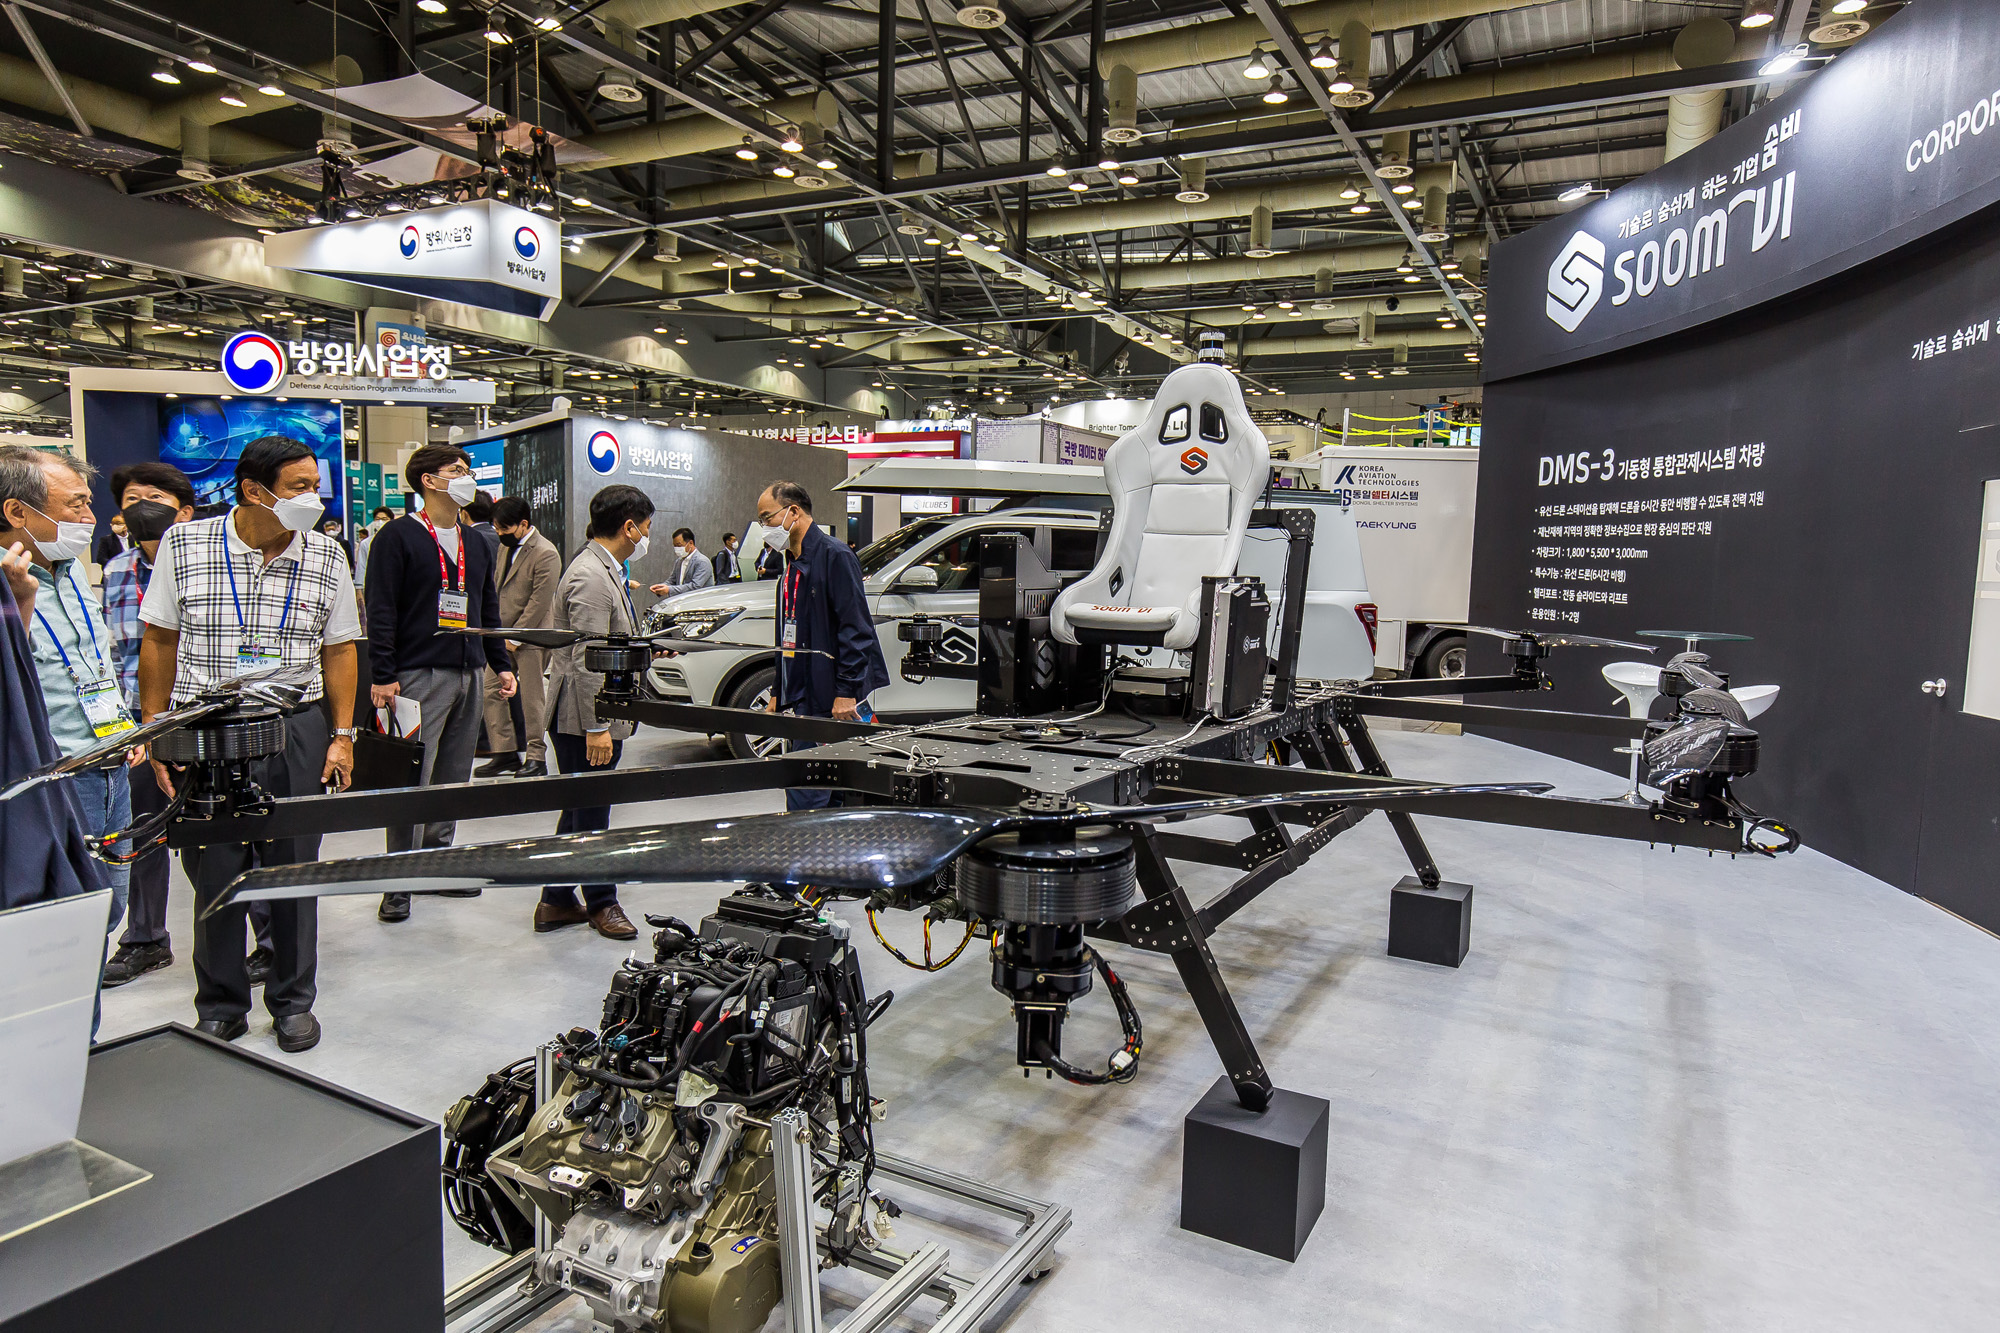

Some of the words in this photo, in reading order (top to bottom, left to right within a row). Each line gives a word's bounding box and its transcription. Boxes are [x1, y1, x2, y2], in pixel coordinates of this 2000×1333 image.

[1617, 208, 1654, 240] 기술로
[1657, 186, 1696, 223] 숨쉬게
[1701, 173, 1728, 201] 하는
[1732, 152, 1760, 185] 기업
[1761, 108, 1802, 172] 숨비
[425, 225, 473, 247] 방위사업청
[506, 260, 547, 282] 방위사업청
[1911, 334, 1947, 362] 기술로
[1951, 319, 1990, 352] 숨쉬게
[288, 340, 453, 381] 방위사업청
[289, 381, 322, 390] Defense
[323, 382, 366, 393] Acquisition
[367, 384, 400, 394] Program
[401, 385, 457, 395] Administration
[1089, 423, 1118, 433] Brighter
[628, 445, 693, 472] 방위사업청
[1064, 440, 1078, 458] 국방
[1078, 443, 1097, 461] 데이터
[1538, 448, 1616, 487] DMS-3
[1617, 456, 1651, 481] 기동형
[1652, 446, 1737, 478] 통합관제시스템
[1738, 441, 1766, 468] 차량
[1358, 479, 1420, 487] TECHNOLOGIES
[1539, 505, 1553, 517] 유선
[1553, 504, 1566, 517] 드론
[1566, 502, 1599, 516] 스테이션을
[1620, 500, 1640, 514] 드론을
[1640, 499, 1660, 512] 6시간
[1660, 498, 1675, 512] 동안
[1676, 496, 1698, 511] 비행할
[1698, 496, 1707, 510] 수
[1708, 494, 1731, 509] 있도록
[1732, 492, 1748, 508] 전력
[1748, 490, 1765, 506] 지원
[1355, 521, 1417, 530] TAEKYUNG
[1538, 525, 1563, 537] 재난재해
[1563, 525, 1583, 537] 지역의
[1583, 524, 1603, 537] 정확한
[1604, 523, 1643, 537] 정보수집으로
[1643, 522, 1658, 536] 현장
[1658, 522, 1680, 536] 중심의
[1681, 521, 1697, 536] 판단
[1697, 520, 1713, 535] 지원
[1566, 547, 1585, 559] 1,800
[1590, 547, 1610, 559] 5,500
[1615, 547, 1648, 559] 3,000mm
[1564, 568, 1577, 580] 유선
[1610, 569, 1627, 582] 비행)
[1562, 589, 1575, 602] 전동
[1576, 590, 1608, 604] 슬라이드와
[1608, 592, 1628, 605] 리프트
[1561, 611, 1580, 623] 1~2명
